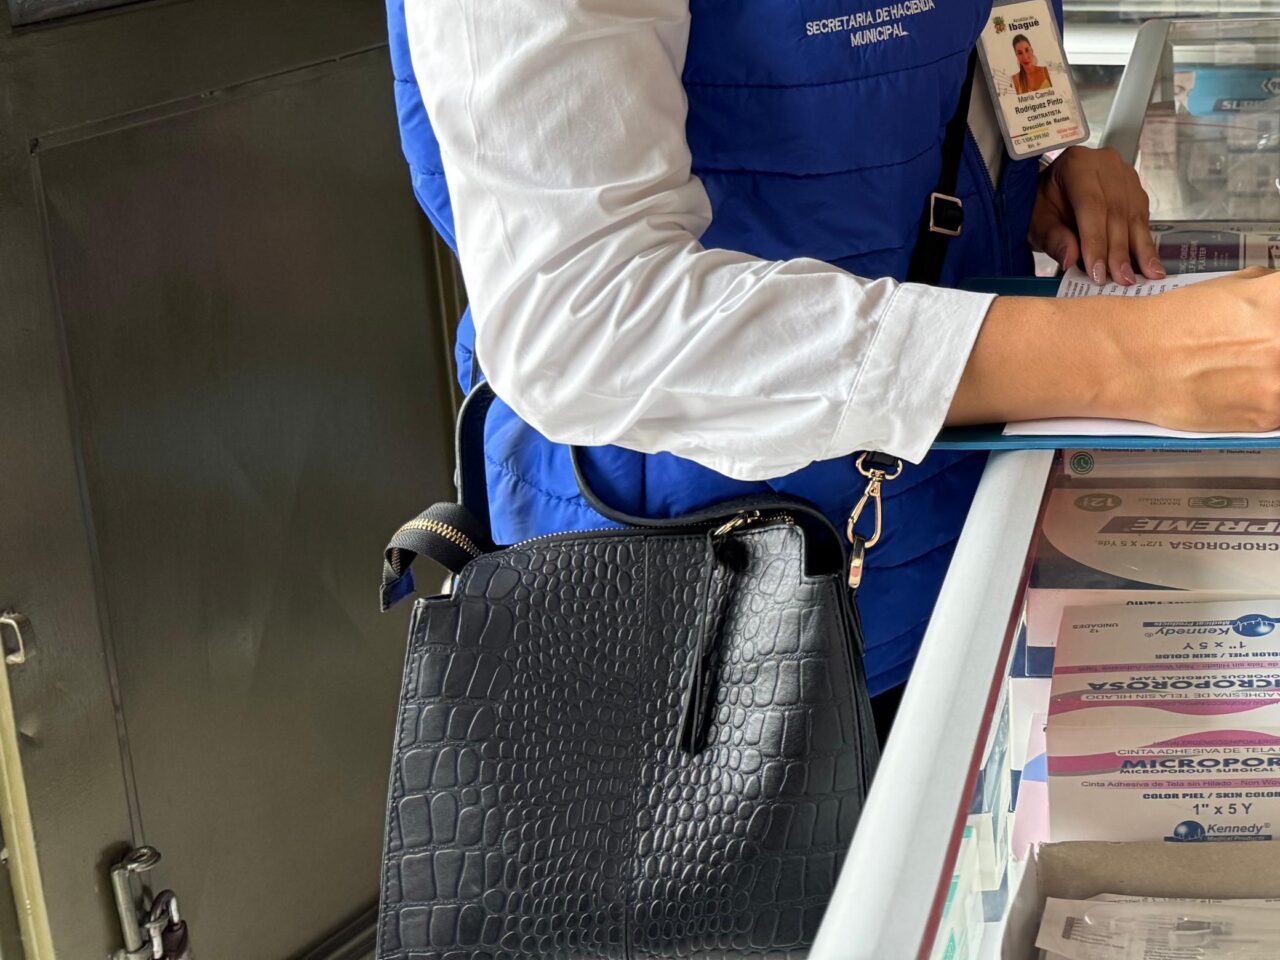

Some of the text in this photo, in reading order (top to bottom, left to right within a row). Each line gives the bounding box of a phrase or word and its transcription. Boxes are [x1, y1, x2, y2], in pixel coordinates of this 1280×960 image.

[806, 11, 874, 36] SECRETARIA
[876, 7, 890, 22] DE
[1008, 19, 1040, 31] Ibagué
[850, 22, 910, 47] MUNICIPAL
[1046, 97, 1063, 107] Pinto
[1027, 109, 1061, 121] CONTRATISTA
[1155, 627, 1230, 636] Kennedy
[1182, 642, 1194, 650] Y
[1192, 803, 1253, 815] 1" x 5 Y
[1207, 824, 1263, 835] Kennedy
